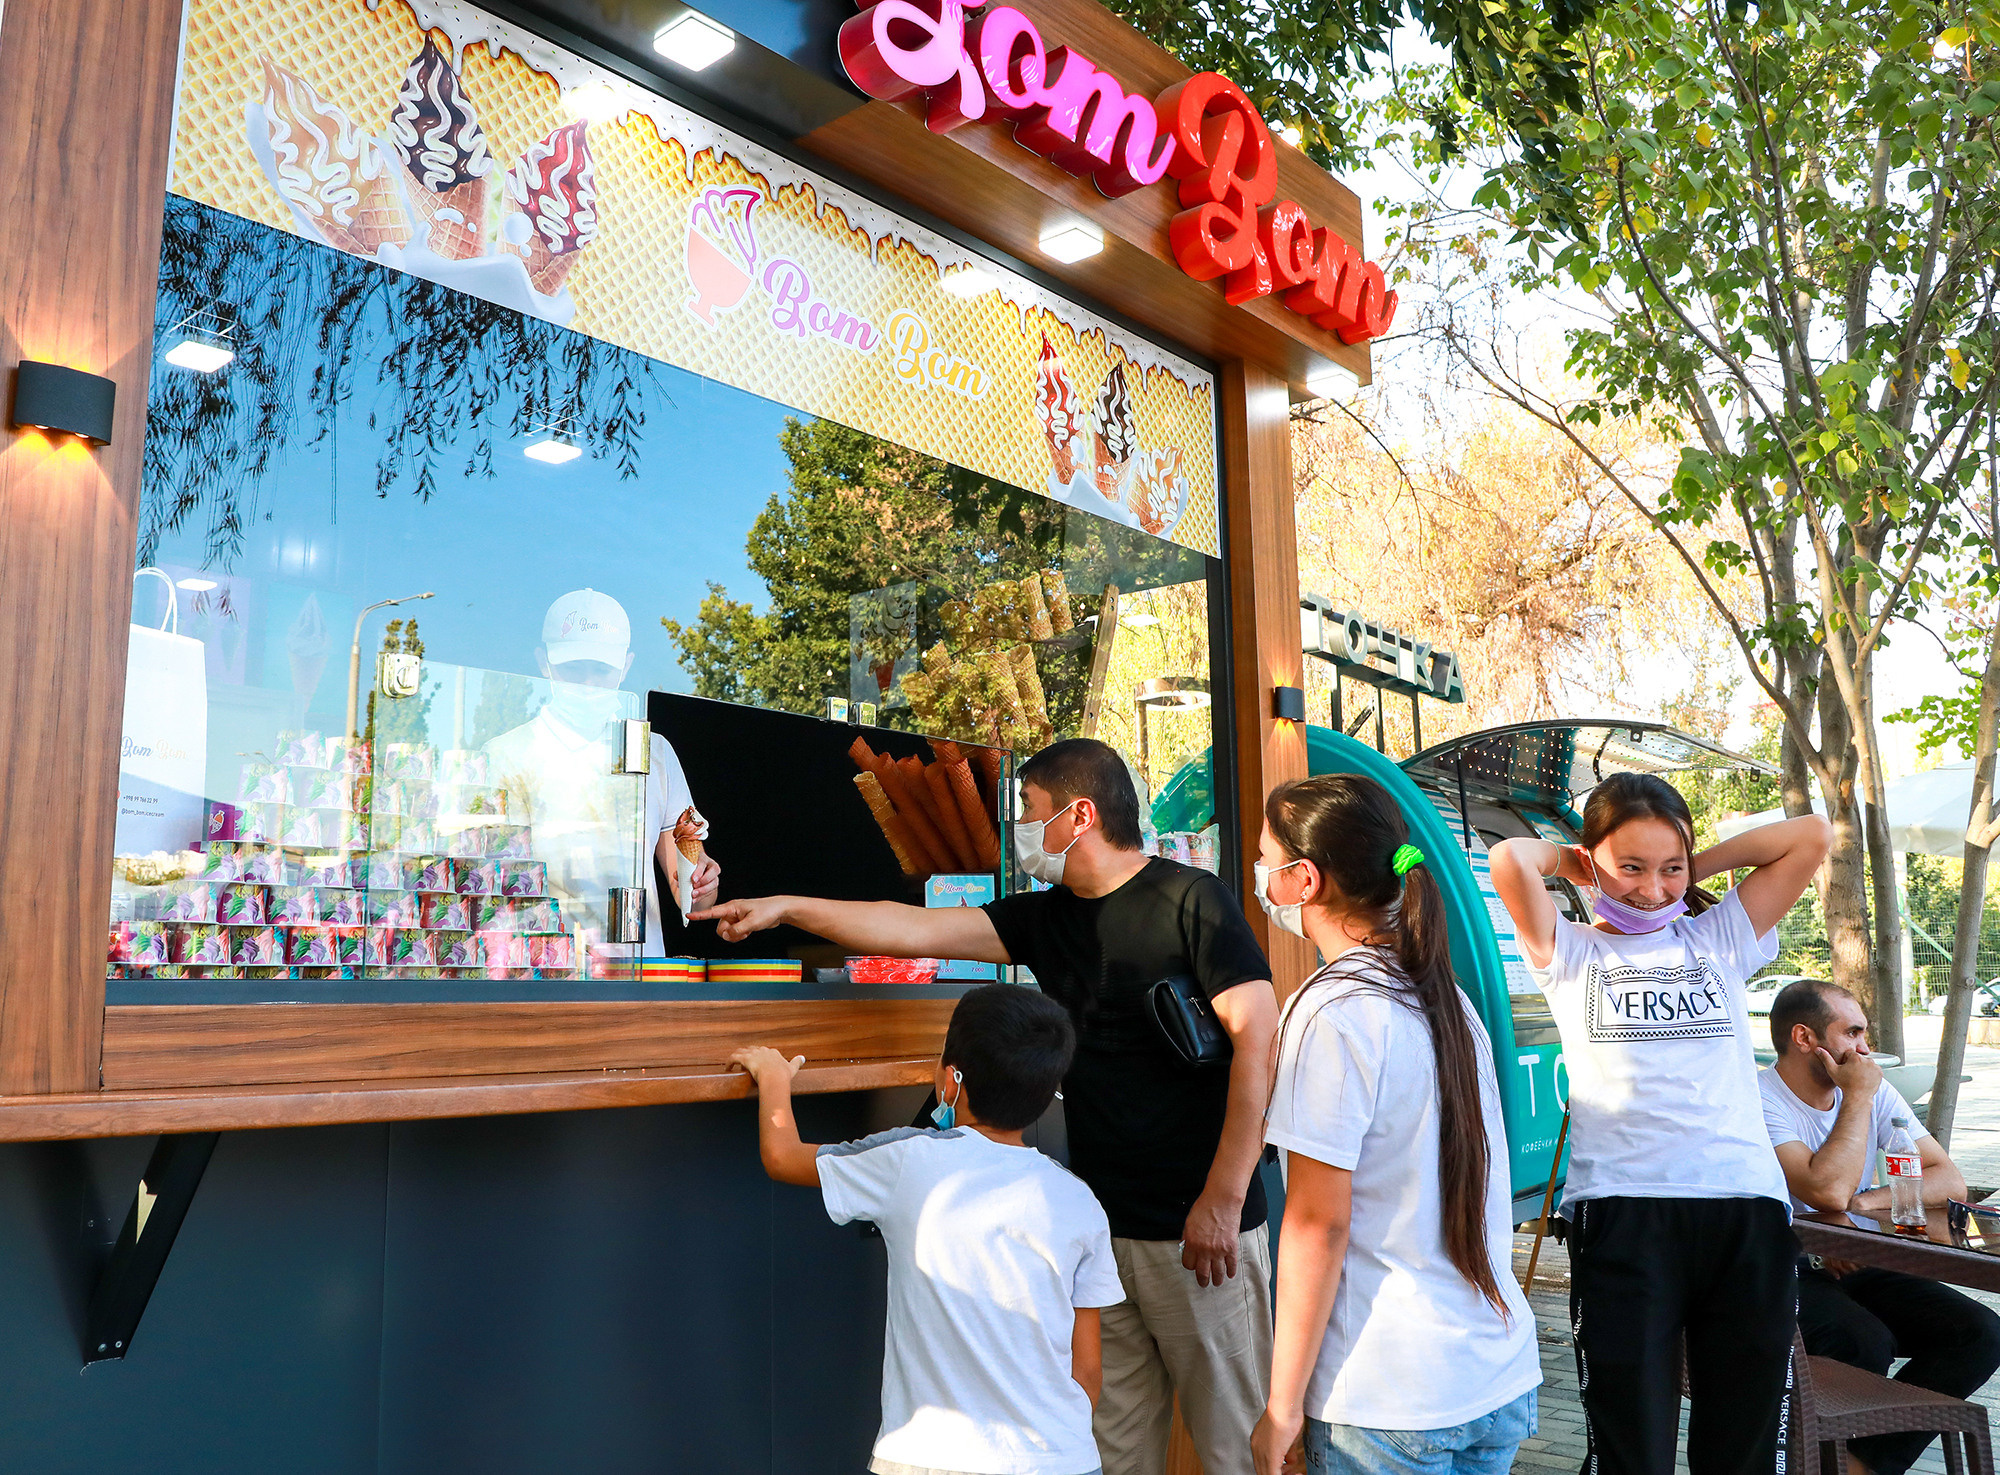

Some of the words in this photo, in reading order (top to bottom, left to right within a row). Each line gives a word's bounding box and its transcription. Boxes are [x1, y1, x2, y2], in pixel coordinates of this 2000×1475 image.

[1170, 71, 1397, 342] Bom
[763, 259, 878, 350] Bom
[889, 312, 988, 396] Bom
[1306, 592, 1466, 703] ТОЧКА
[121, 736, 152, 758] Bom
[1606, 981, 1721, 1021] VERSACE
[1777, 1394, 1791, 1446] VERSACE
